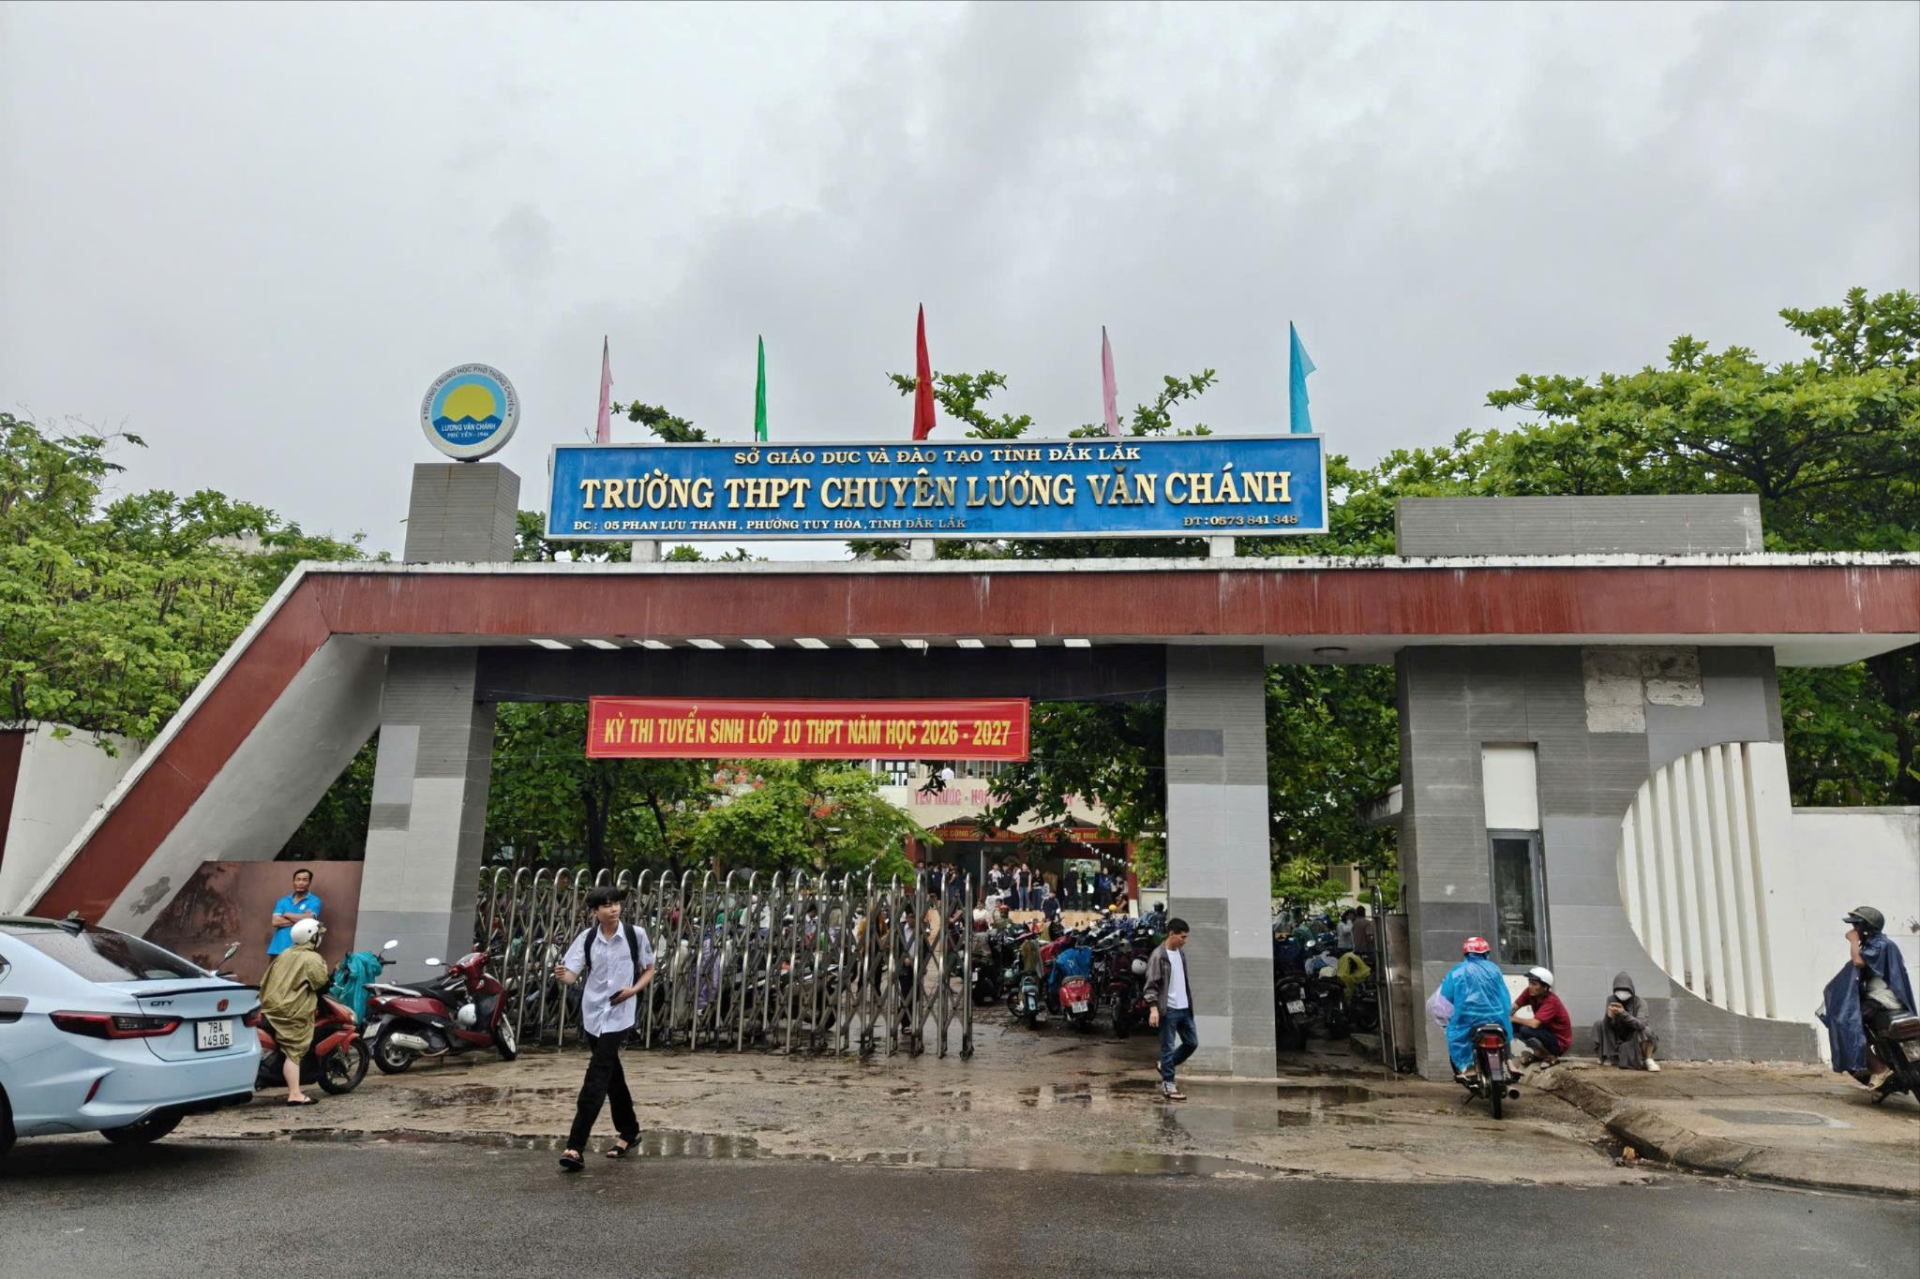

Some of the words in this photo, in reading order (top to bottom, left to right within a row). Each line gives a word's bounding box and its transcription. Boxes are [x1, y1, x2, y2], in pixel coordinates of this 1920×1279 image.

[734, 446, 760, 465] SỞ
[766, 448, 816, 465] GIÁO
[821, 450, 861, 467] DỤC
[866, 447, 890, 464] VÀ
[896, 447, 937, 463] ĐÀO
[943, 449, 983, 465] TẠO
[990, 445, 1041, 462] TỈNH
[1048, 442, 1093, 461] ĐẮK
[1097, 441, 1141, 461] LẮK
[579, 467, 714, 509] TRƯỜNG
[724, 477, 811, 509] THPT
[820, 467, 957, 508] CHUYÊN
[966, 468, 1076, 507] LƯƠNG
[1086, 465, 1158, 506] VĂN
[1164, 462, 1292, 504] CHÁNH
[604, 520, 620, 530] 05
[622, 520, 658, 530] PHAN
[660, 519, 686, 530] LƯU
[746, 517, 799, 530] PHƯỜNG
[803, 520, 830, 530] TUY
[906, 514, 934, 529] ĐẮK
[938, 513, 966, 529] LẮK
[1247, 515, 1271, 525] 841
[1273, 514, 1298, 525] 348
[604, 711, 626, 744] KỲ
[630, 718, 655, 744] THI
[658, 705, 706, 744] TUYỂN
[710, 718, 745, 744] SINH
[748, 711, 779, 744] LỚP
[783, 719, 801, 744] 10
[806, 719, 843, 744] THPT
[848, 714, 881, 745] NĂM
[885, 719, 917, 750] HỌC
[920, 720, 958, 745] 2026
[972, 720, 1011, 746] 2027
[208, 1021, 223, 1034] 78A
